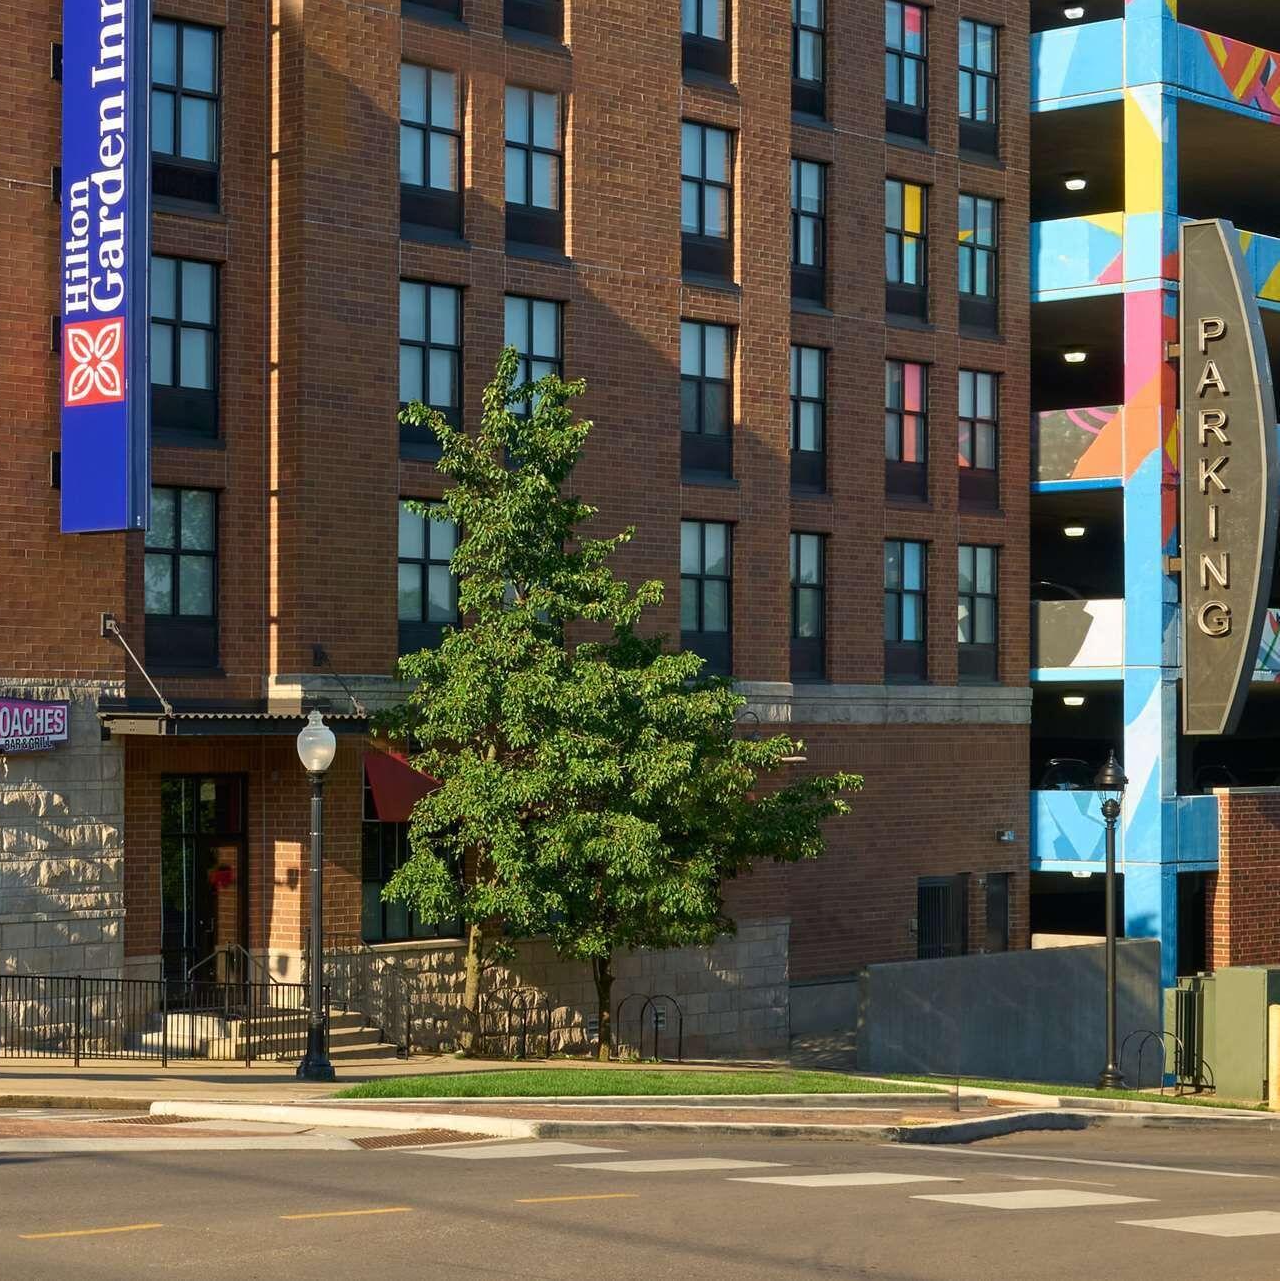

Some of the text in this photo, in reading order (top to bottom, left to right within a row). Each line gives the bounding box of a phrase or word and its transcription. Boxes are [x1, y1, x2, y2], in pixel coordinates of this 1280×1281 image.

[66, 177, 89, 315] Hilton
[90, 89, 125, 312] Garden
[1196, 317, 1230, 637] PARKING
